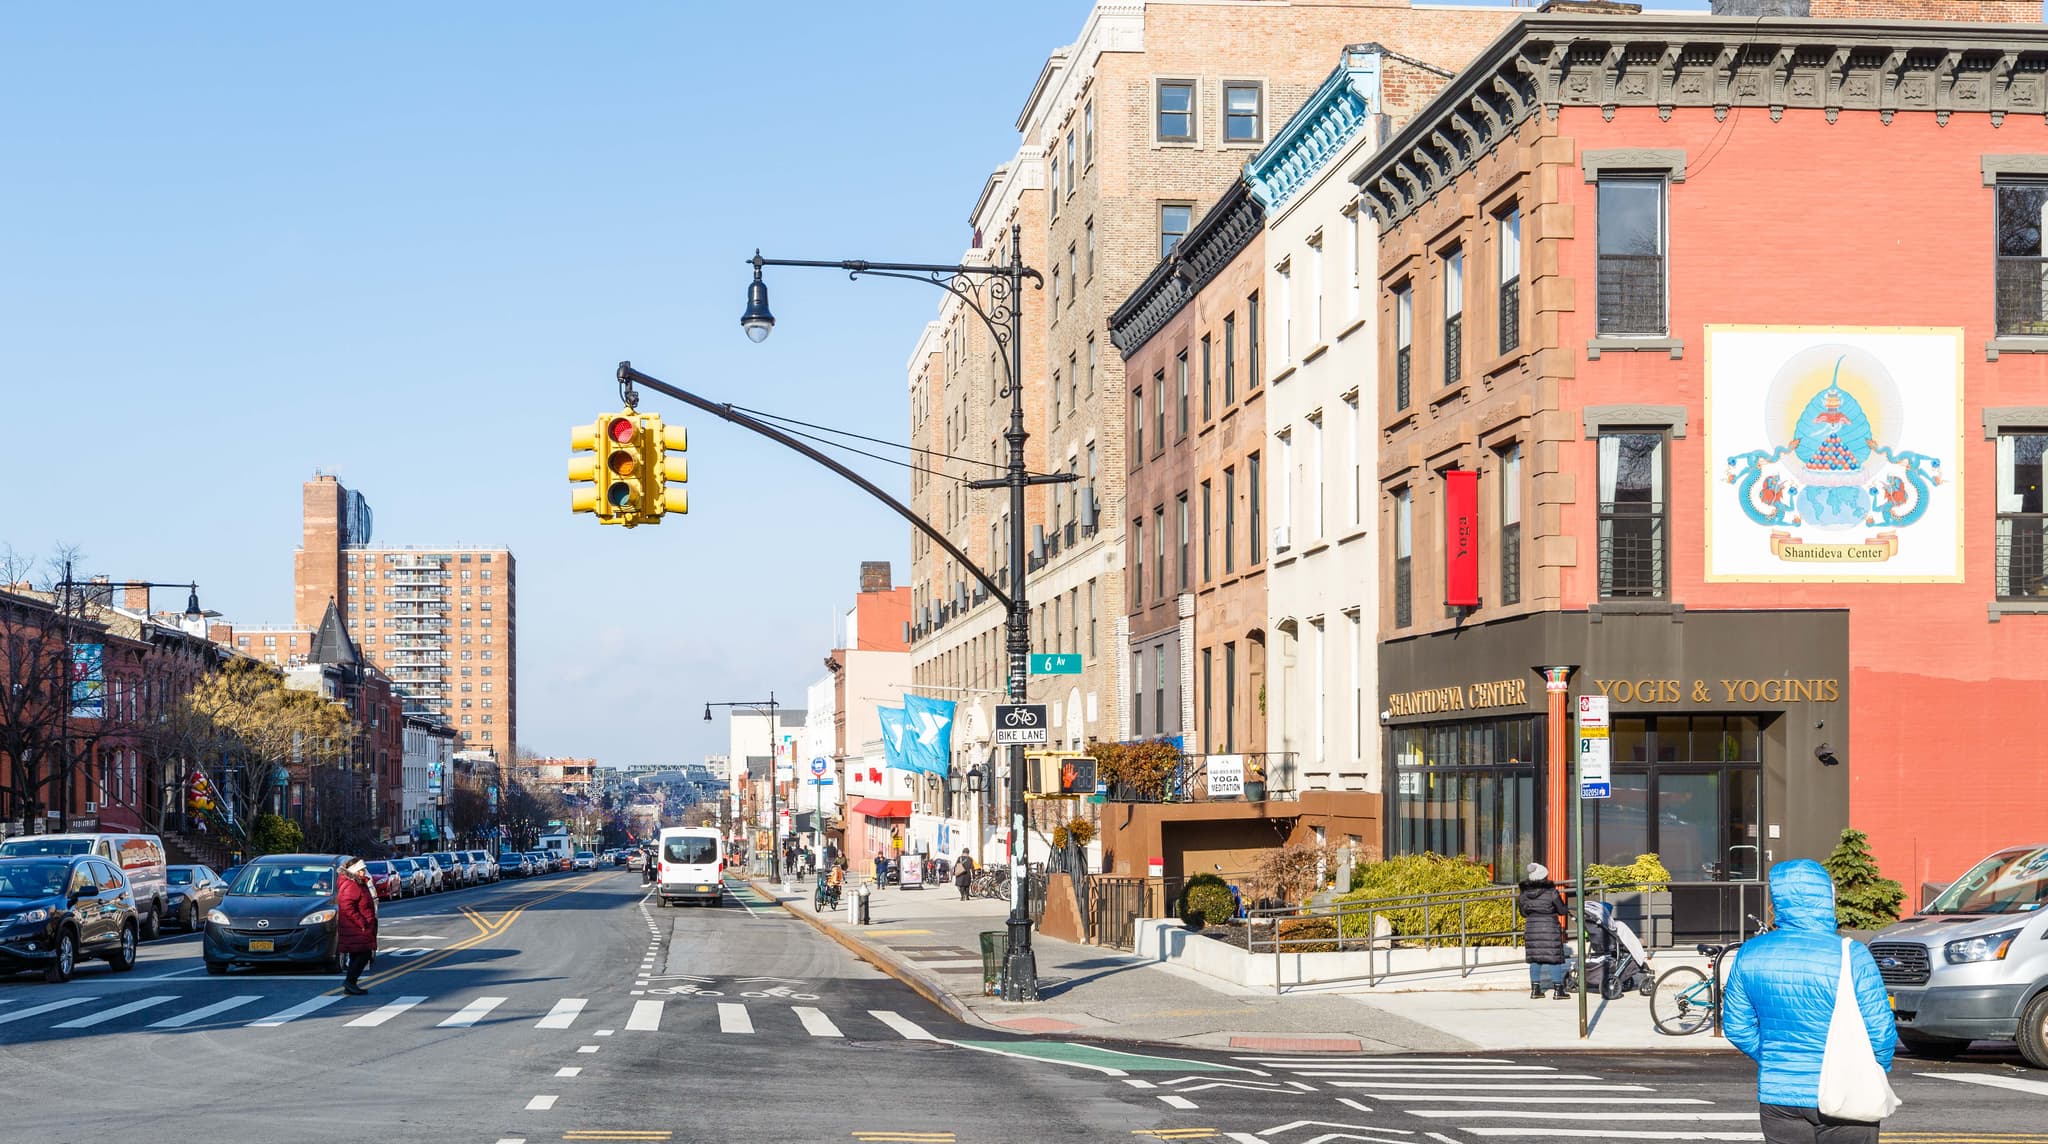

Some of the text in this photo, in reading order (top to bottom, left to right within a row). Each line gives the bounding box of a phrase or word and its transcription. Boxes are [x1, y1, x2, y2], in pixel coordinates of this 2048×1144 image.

[1456, 516, 1470, 558] Yoga
[1784, 546, 1883, 559] Shantideva Center
[1044, 656, 1066, 672] 6 Av
[1389, 678, 1528, 716] SHANTIDEVA CENTER
[1594, 679, 1840, 703] YOGIS & YOGINIS
[998, 729, 1045, 741] BIKE LANE
[1212, 775, 1239, 783] YOGA
[1210, 783, 1241, 792] MEDITATION
